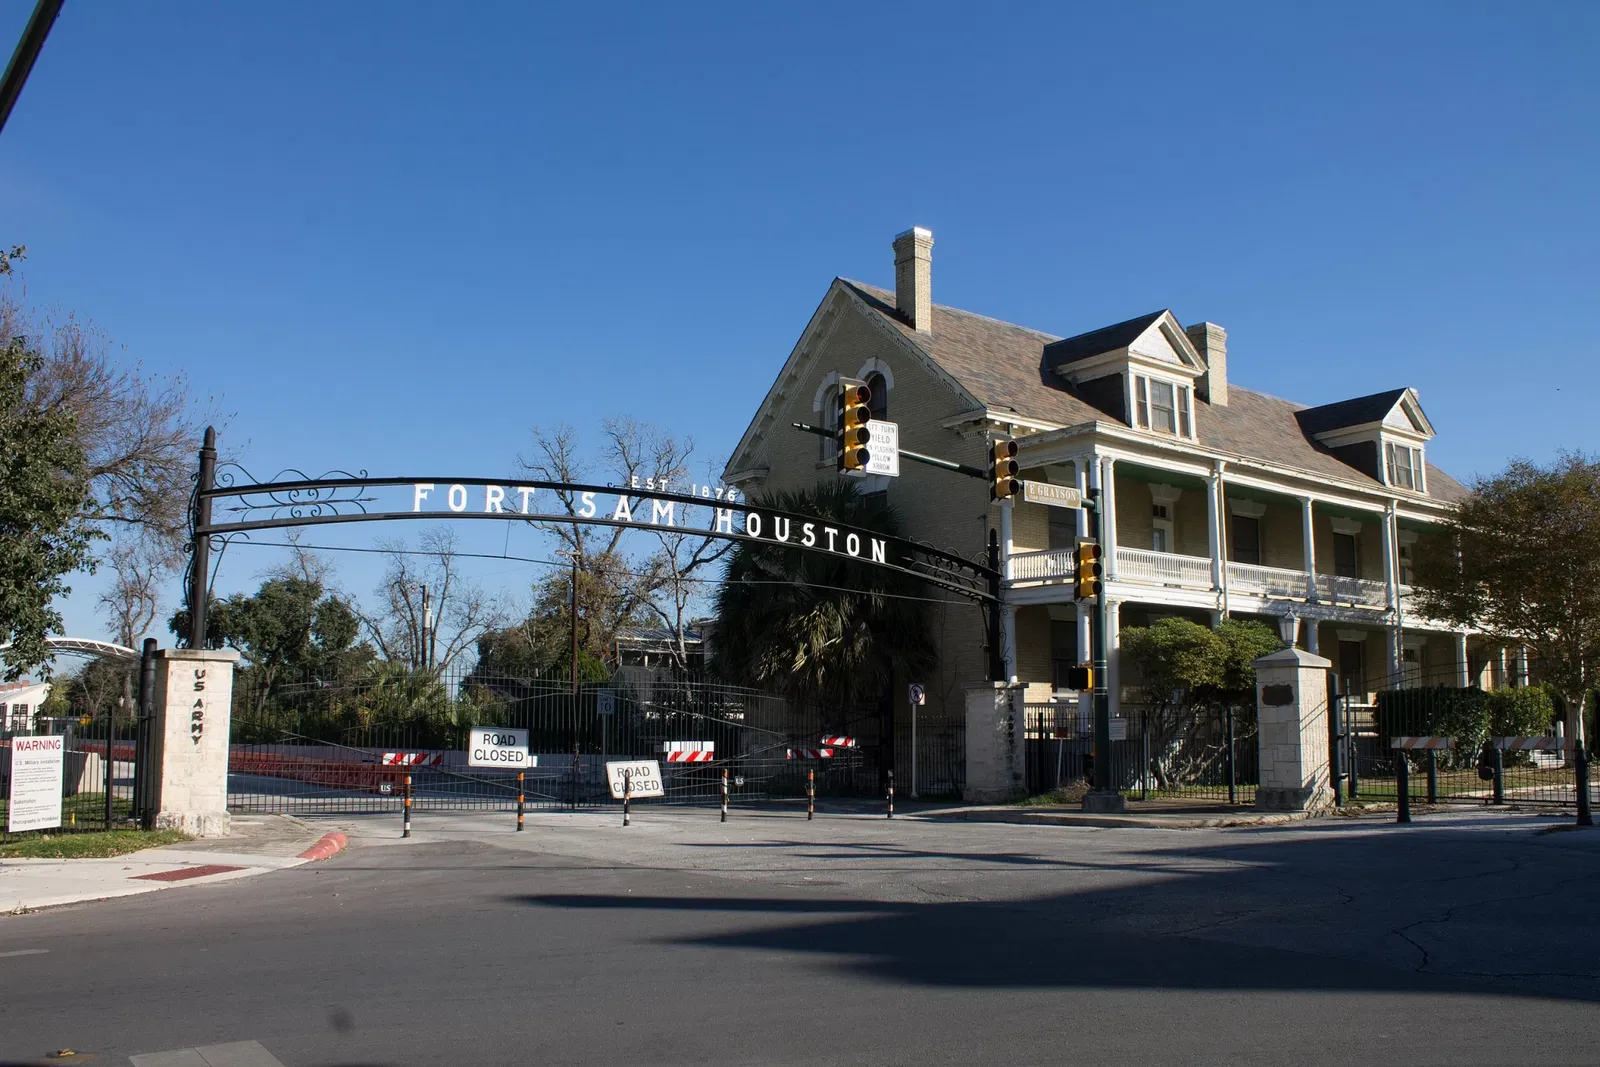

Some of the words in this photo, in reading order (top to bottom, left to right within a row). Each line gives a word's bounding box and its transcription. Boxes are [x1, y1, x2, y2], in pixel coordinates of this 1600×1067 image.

[881, 425, 895, 434] TURN
[870, 434, 891, 444] YIELD
[871, 453, 891, 463] YELLOW
[873, 462, 890, 471] ARROW
[631, 476, 676, 493] EST.
[692, 483, 736, 501] 1876
[1030, 484, 1035, 495] E
[1037, 485, 1076, 501] GRAYSON
[413, 483, 535, 514] FORT
[578, 491, 675, 527] SAM
[715, 507, 886, 564] HOUSTON
[193, 668, 206, 692] US
[191, 698, 204, 745] ARMY
[15, 739, 61, 752] WARNING
[483, 733, 516, 746] ROAD
[474, 749, 524, 762] CLOSED
[617, 766, 650, 778] ROAD
[380, 784, 391, 792] US
[613, 780, 659, 793] CLOSED
